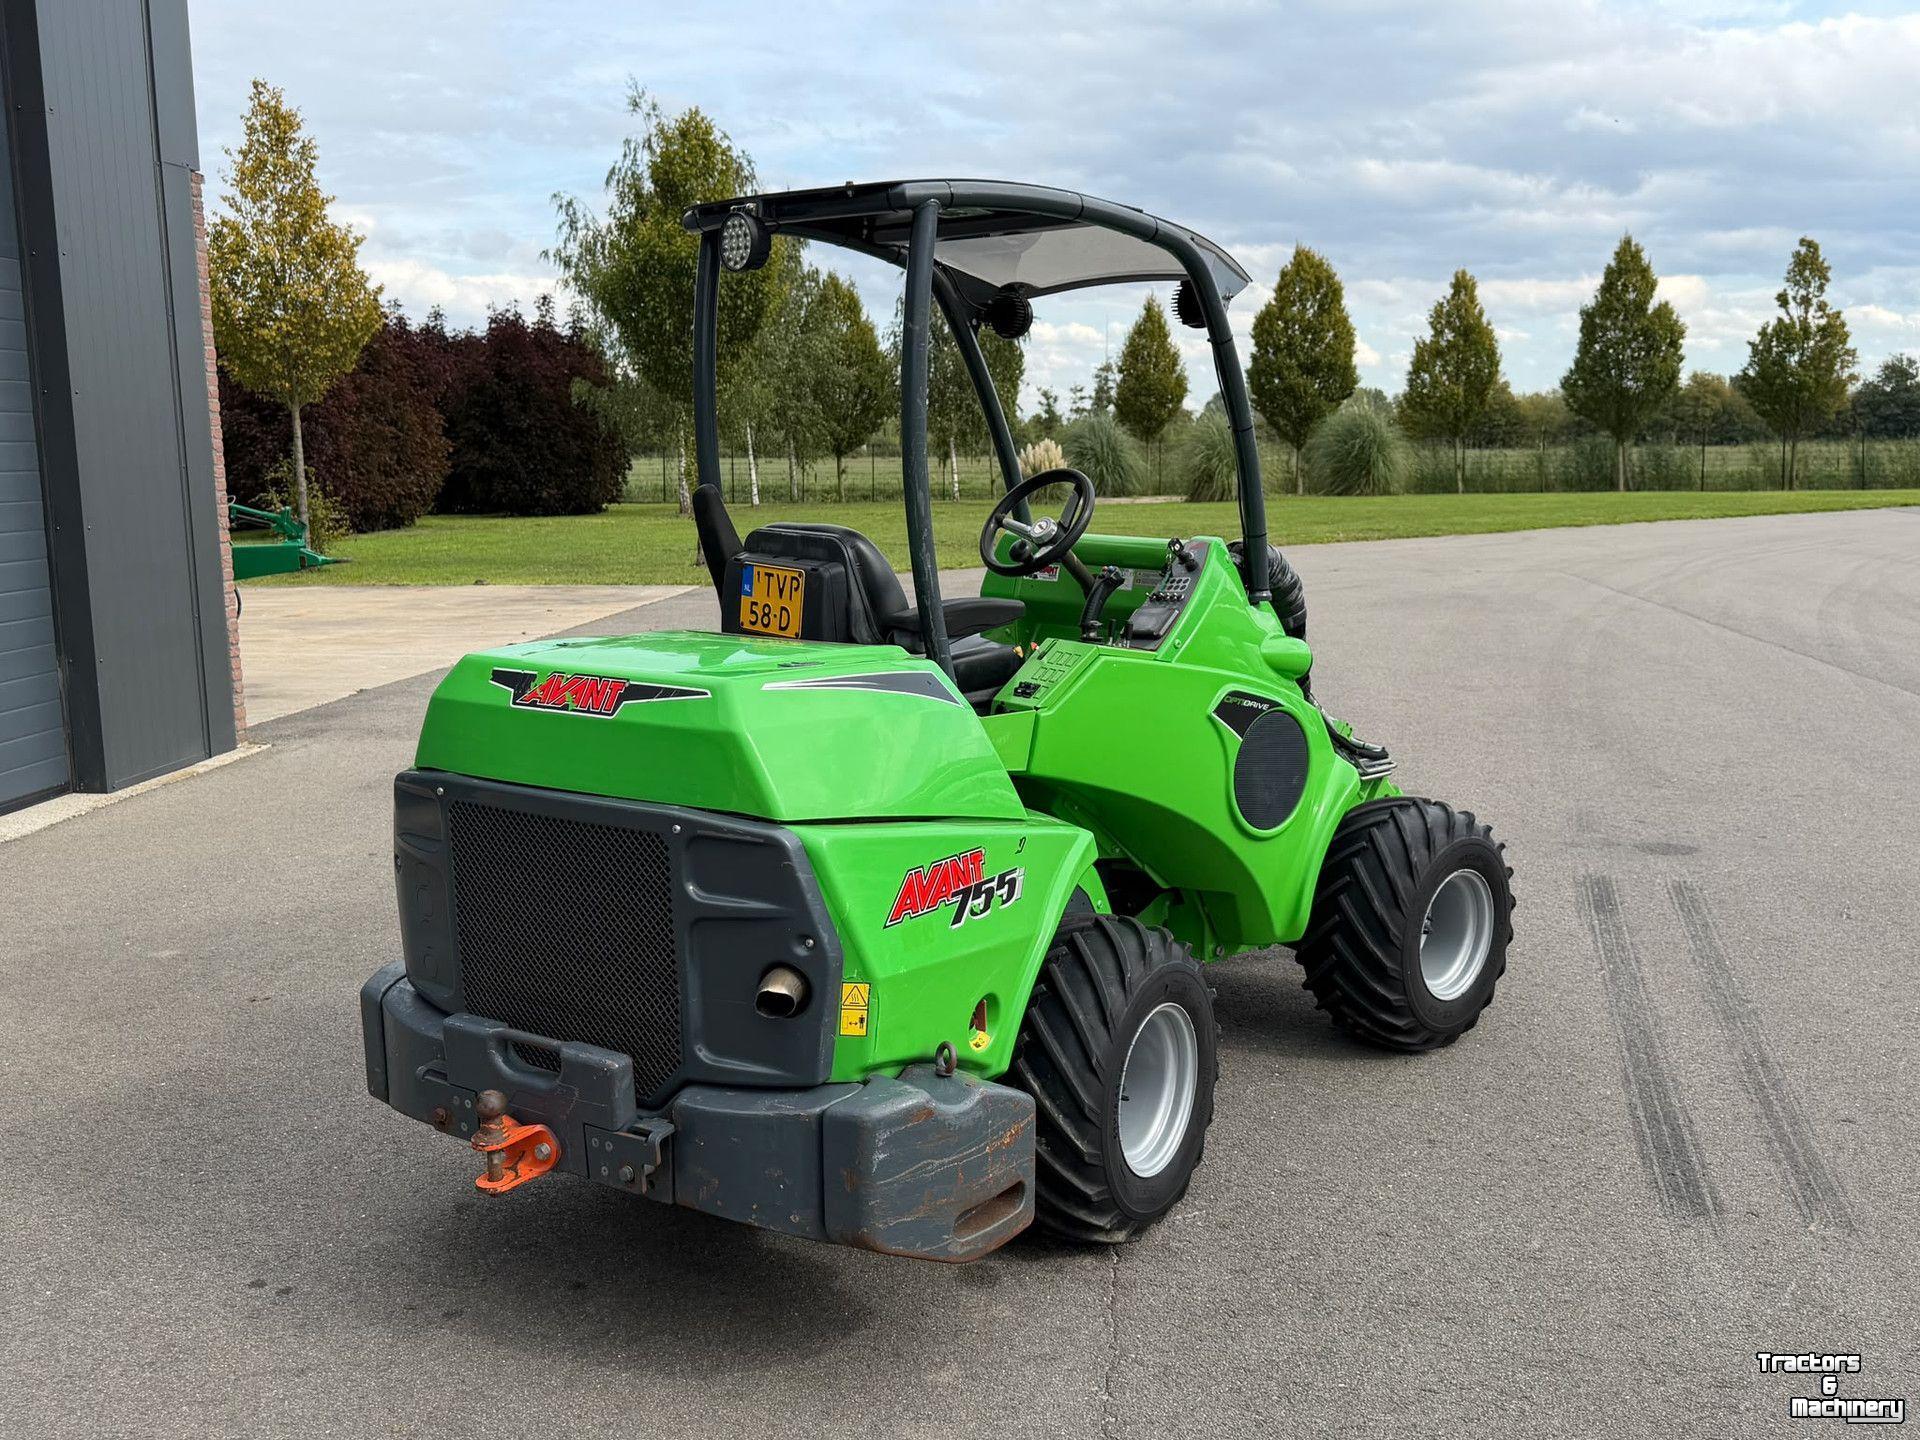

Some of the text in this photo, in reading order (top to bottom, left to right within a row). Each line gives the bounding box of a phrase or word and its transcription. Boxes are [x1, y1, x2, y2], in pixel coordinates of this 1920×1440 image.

[516, 672, 628, 713] AVANT
[1223, 695, 1270, 711] OPTIDRIVE
[884, 847, 984, 927] AVANT
